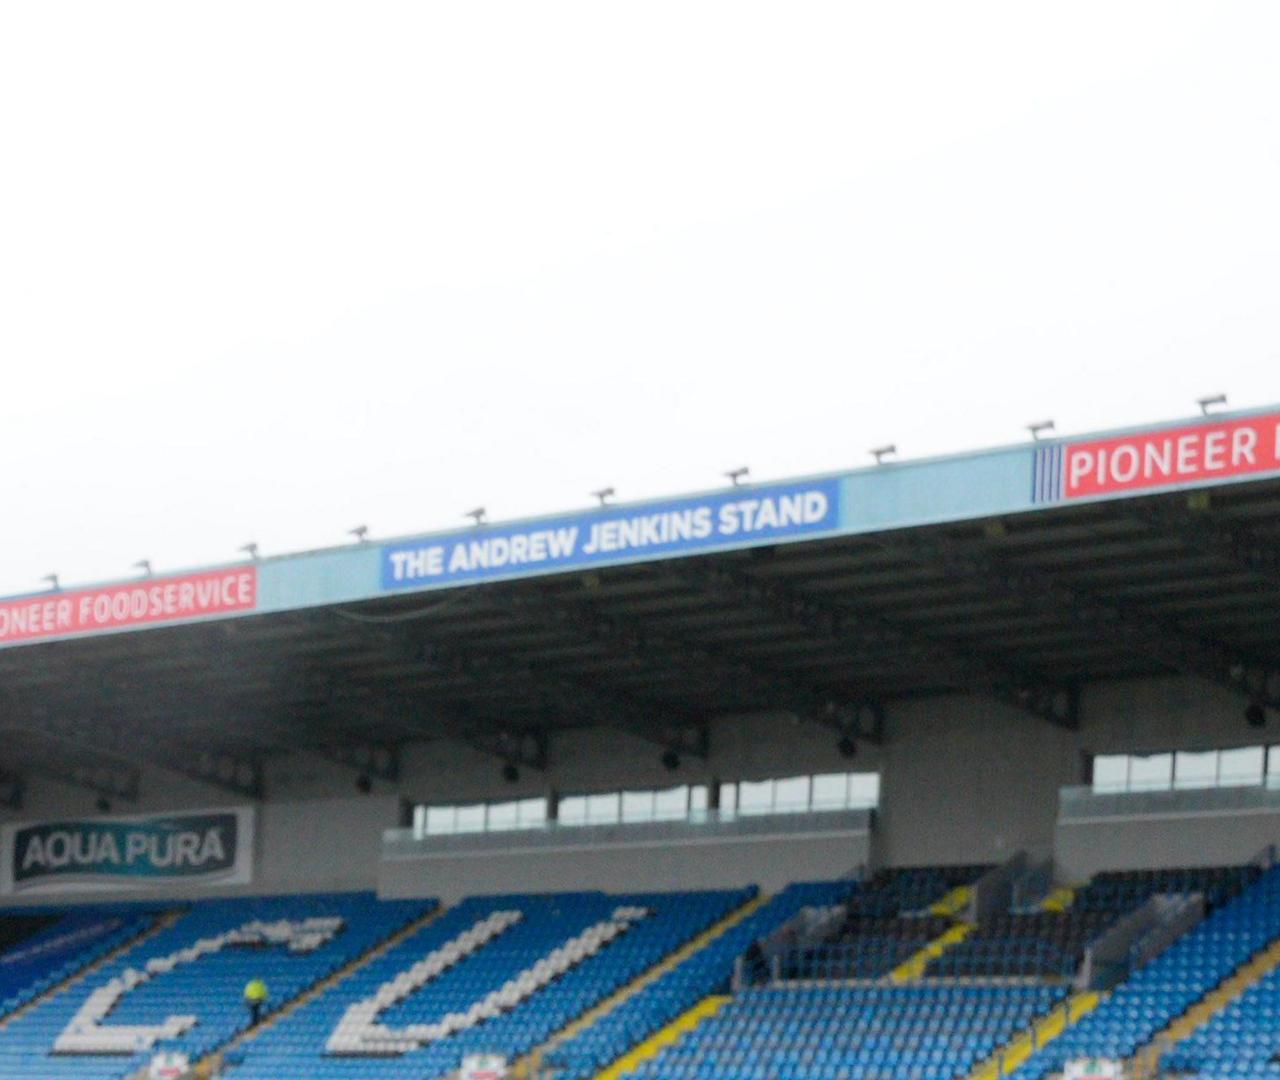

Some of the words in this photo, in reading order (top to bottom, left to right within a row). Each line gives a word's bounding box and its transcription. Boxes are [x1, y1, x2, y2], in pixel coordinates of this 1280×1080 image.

[1070, 425, 1257, 489] PIONEER
[390, 545, 443, 580] THE
[449, 527, 577, 573] ANDREW
[583, 505, 712, 554] JENKINS
[719, 491, 827, 534] STAND
[79, 573, 252, 624] FOODSERVICE
[23, 830, 120, 870] AQUA
[126, 829, 225, 867] PURA
